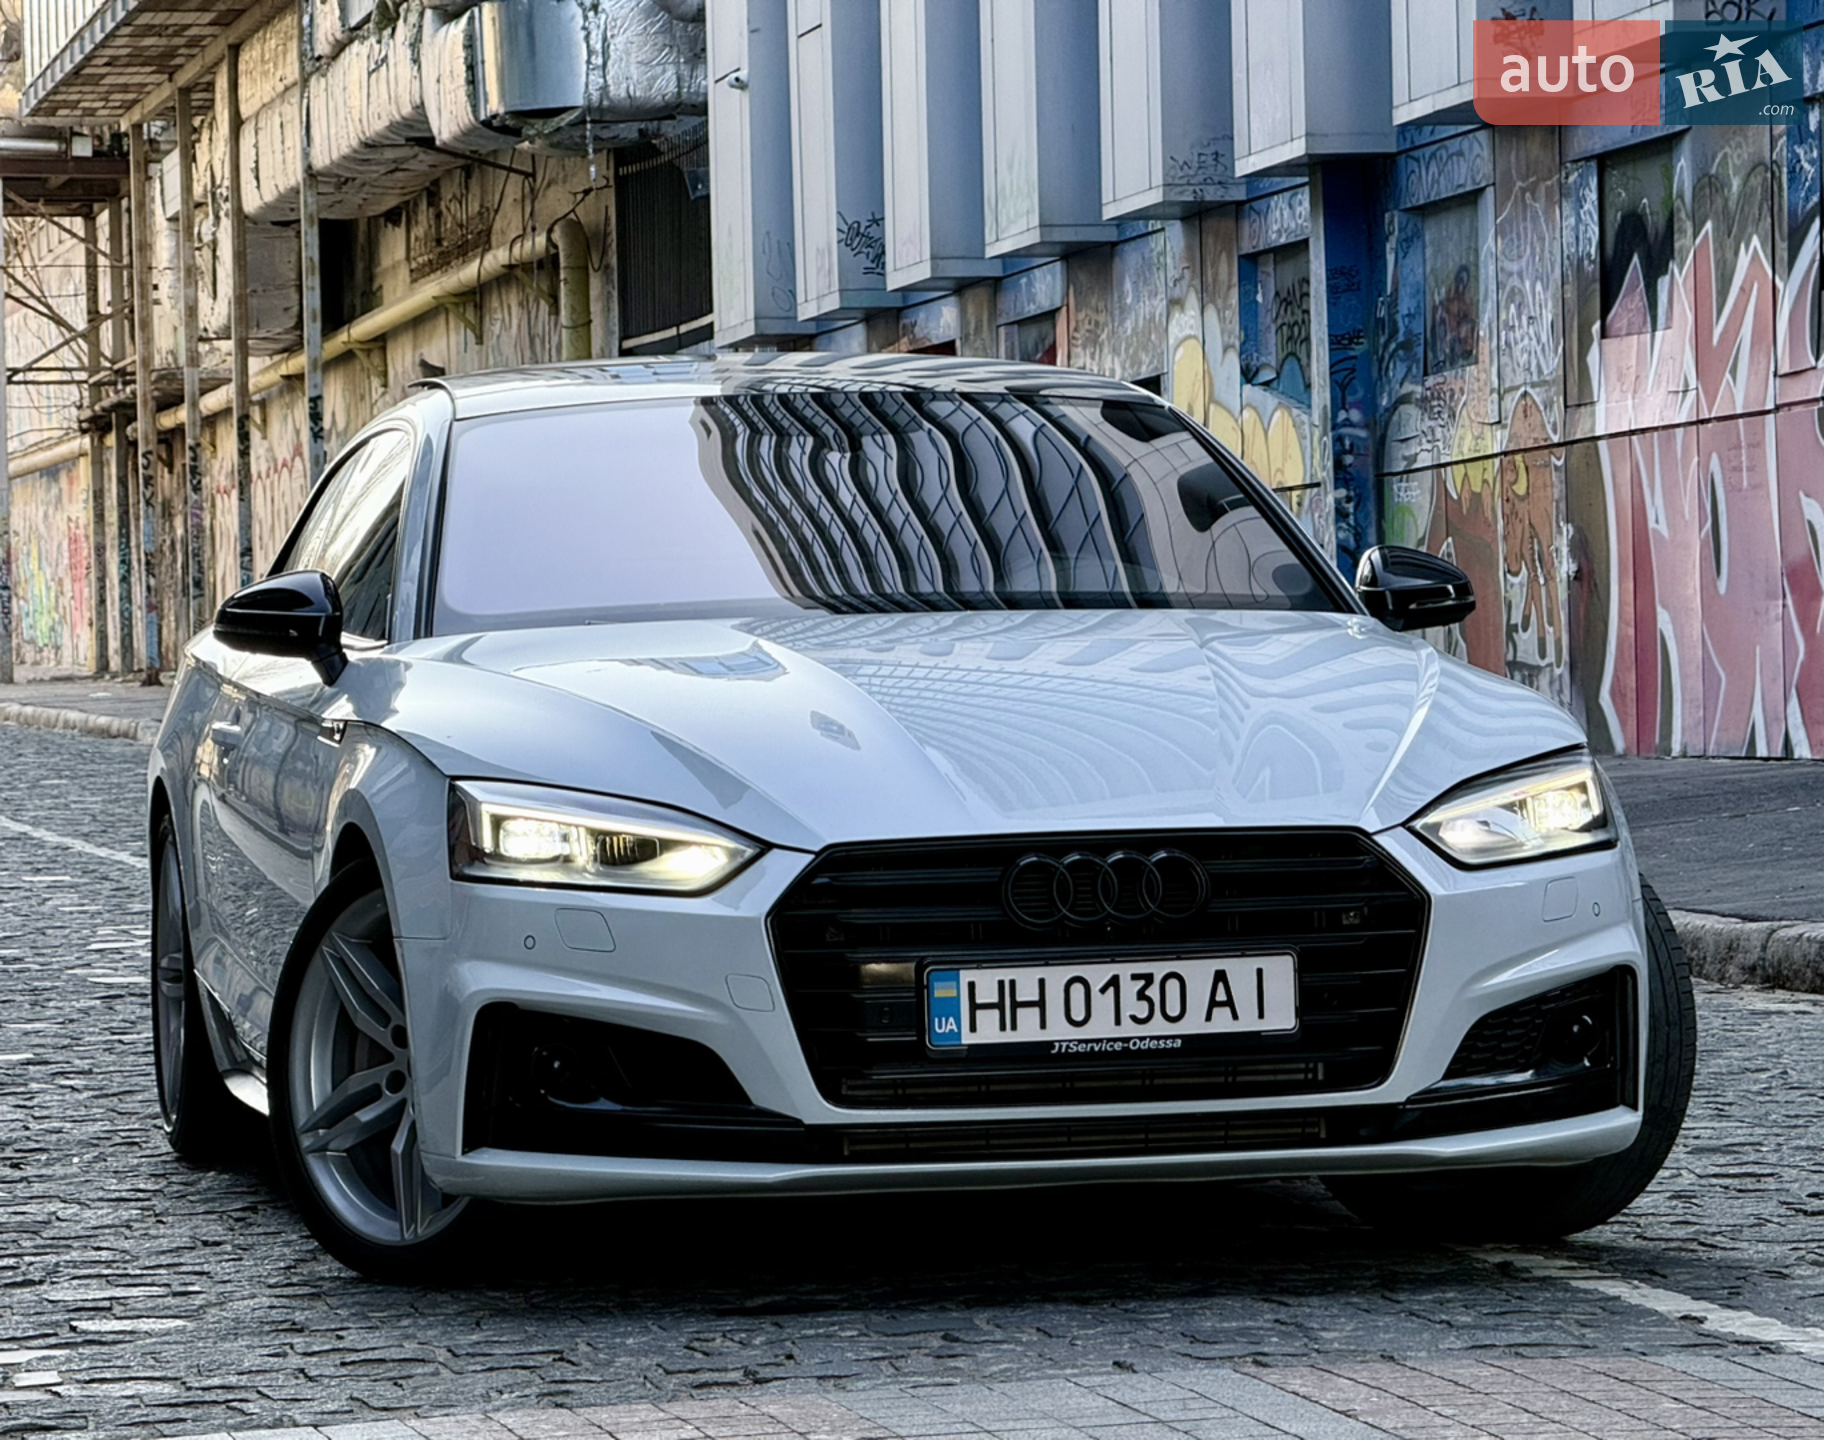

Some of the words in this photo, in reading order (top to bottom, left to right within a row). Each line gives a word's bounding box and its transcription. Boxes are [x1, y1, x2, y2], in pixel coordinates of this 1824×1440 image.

[934, 1016, 958, 1034] UA
[967, 976, 1047, 1034] HH
[1063, 970, 1188, 1029] 0130
[1050, 1038, 1182, 1054] JTService-Odessa
